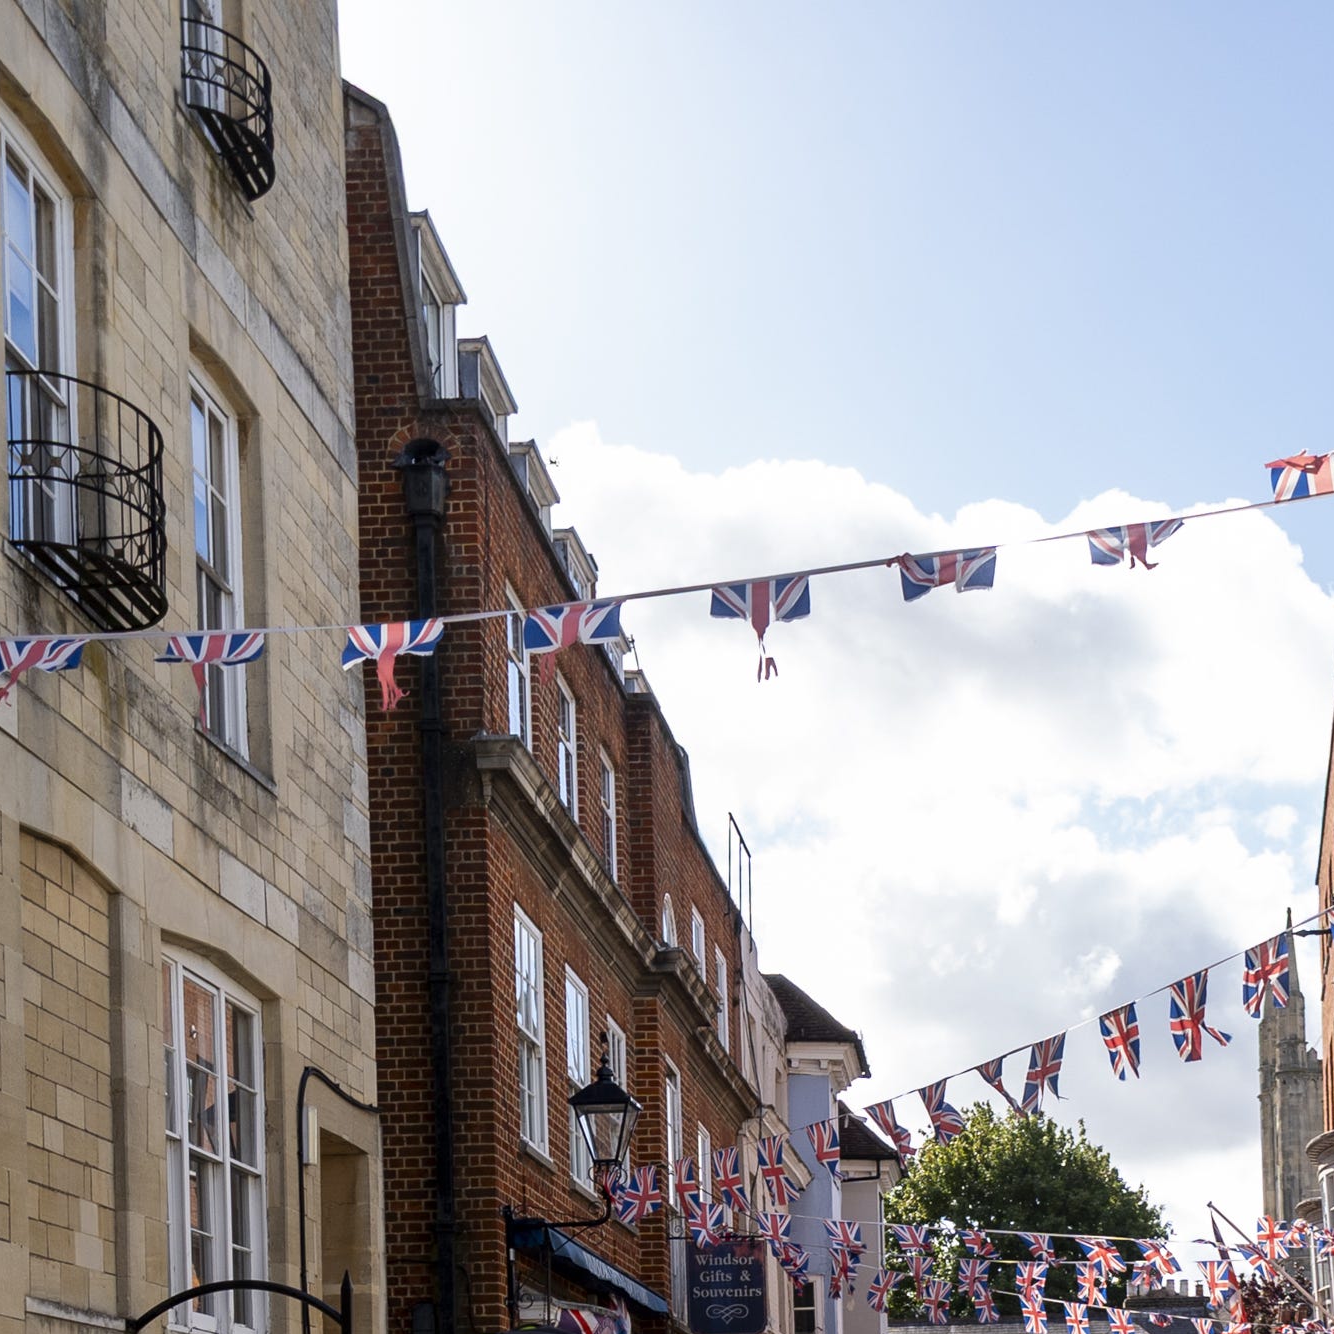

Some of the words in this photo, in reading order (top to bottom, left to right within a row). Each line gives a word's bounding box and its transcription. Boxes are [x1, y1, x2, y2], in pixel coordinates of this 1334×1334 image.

[695, 1253, 755, 1266] Windsor
[699, 1269, 732, 1283] Gifts
[740, 1269, 751, 1281] &
[693, 1285, 762, 1298] Souvenirs
